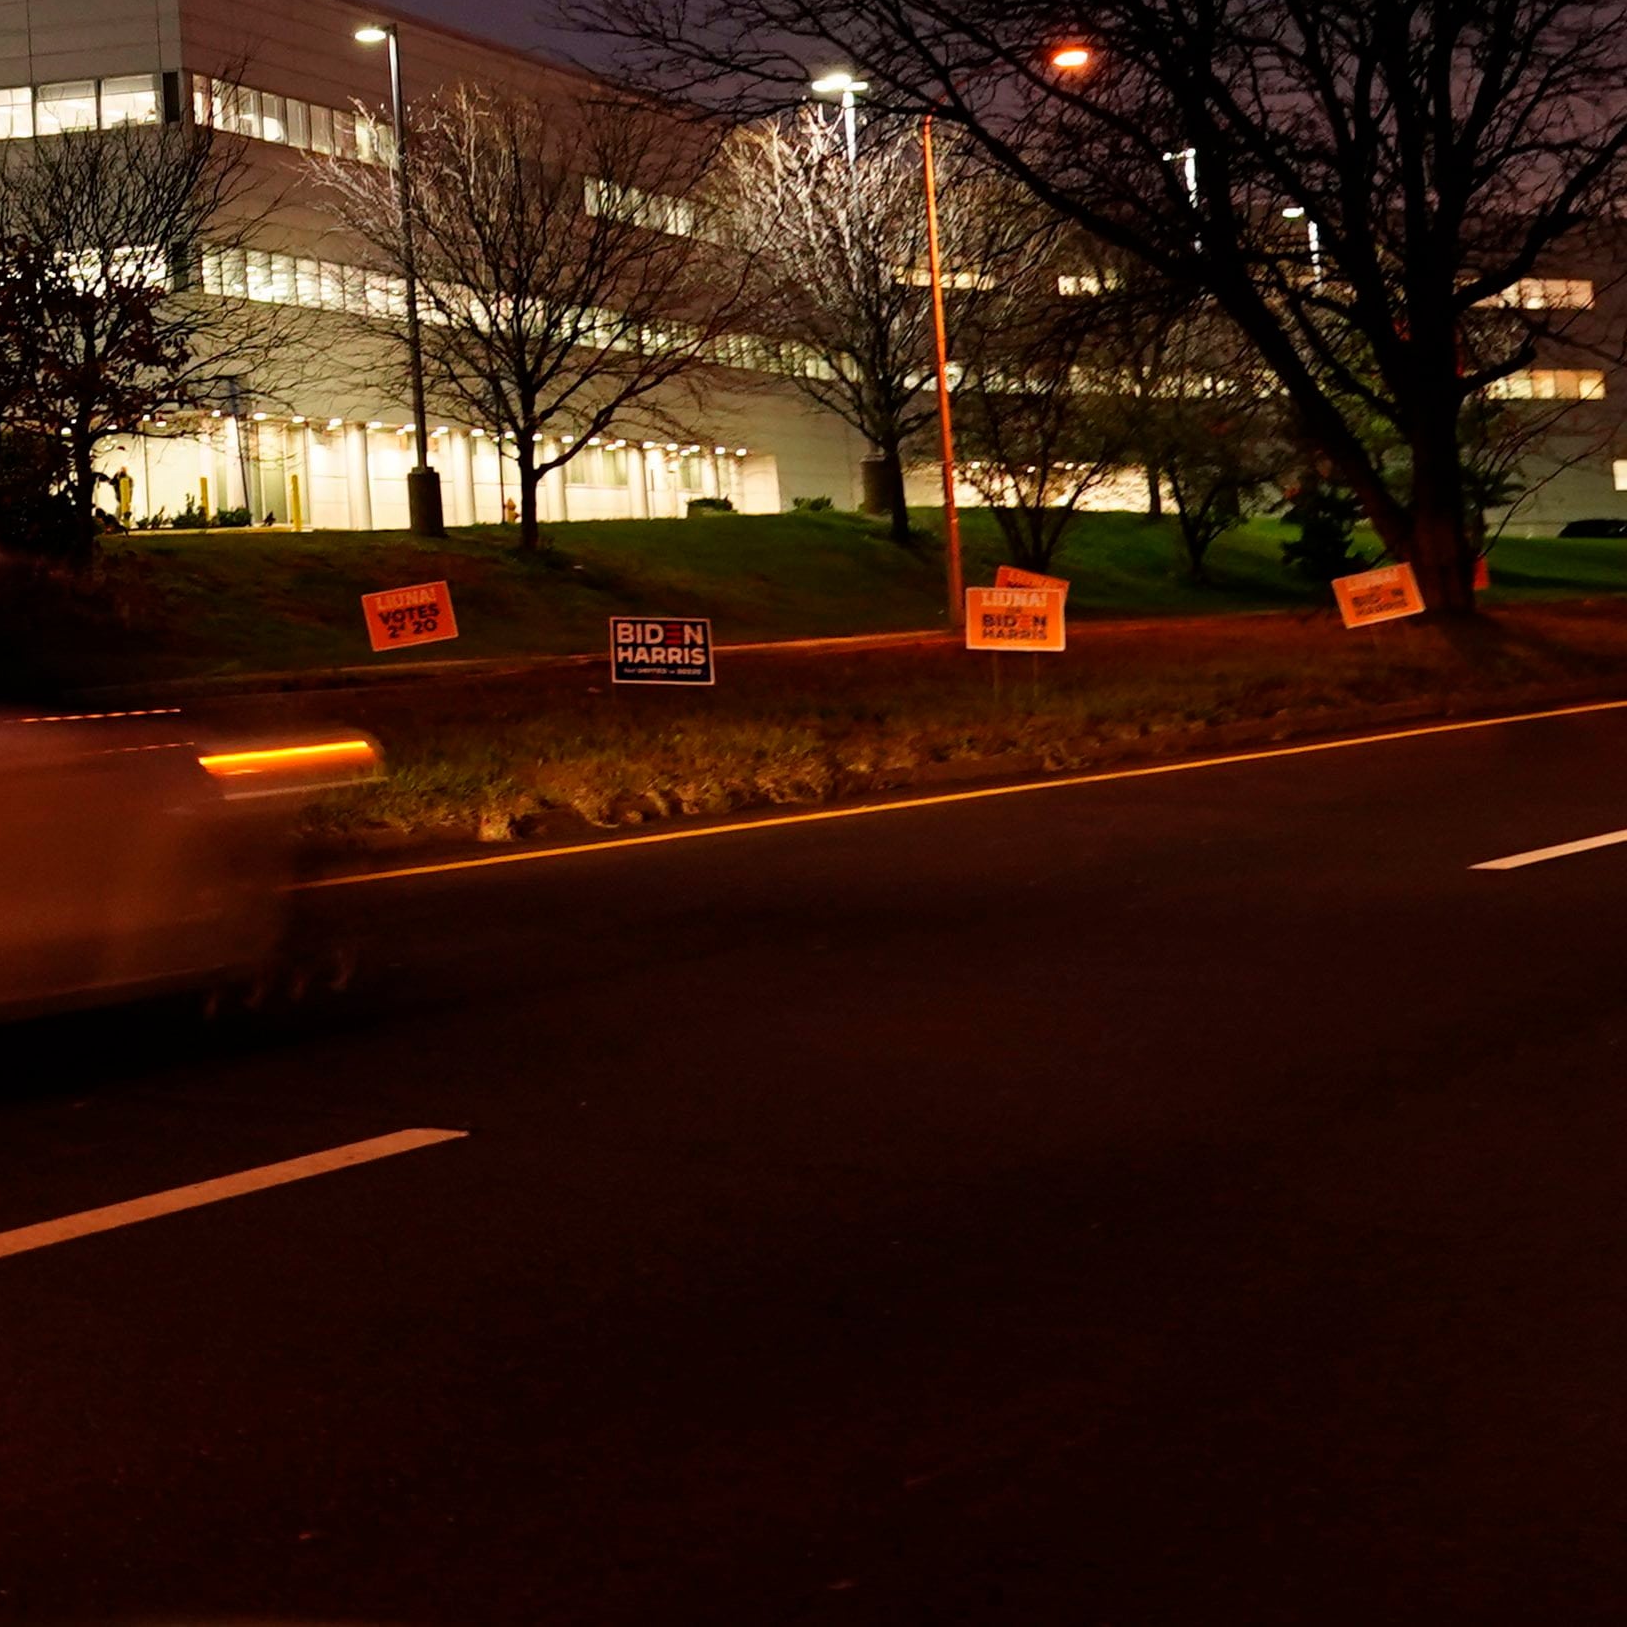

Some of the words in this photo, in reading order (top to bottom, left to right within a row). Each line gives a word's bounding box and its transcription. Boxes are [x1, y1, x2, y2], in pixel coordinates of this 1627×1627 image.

[378, 603, 440, 625] VOTES
[616, 622, 705, 646] BIDEN
[616, 645, 707, 666] HARRIS
